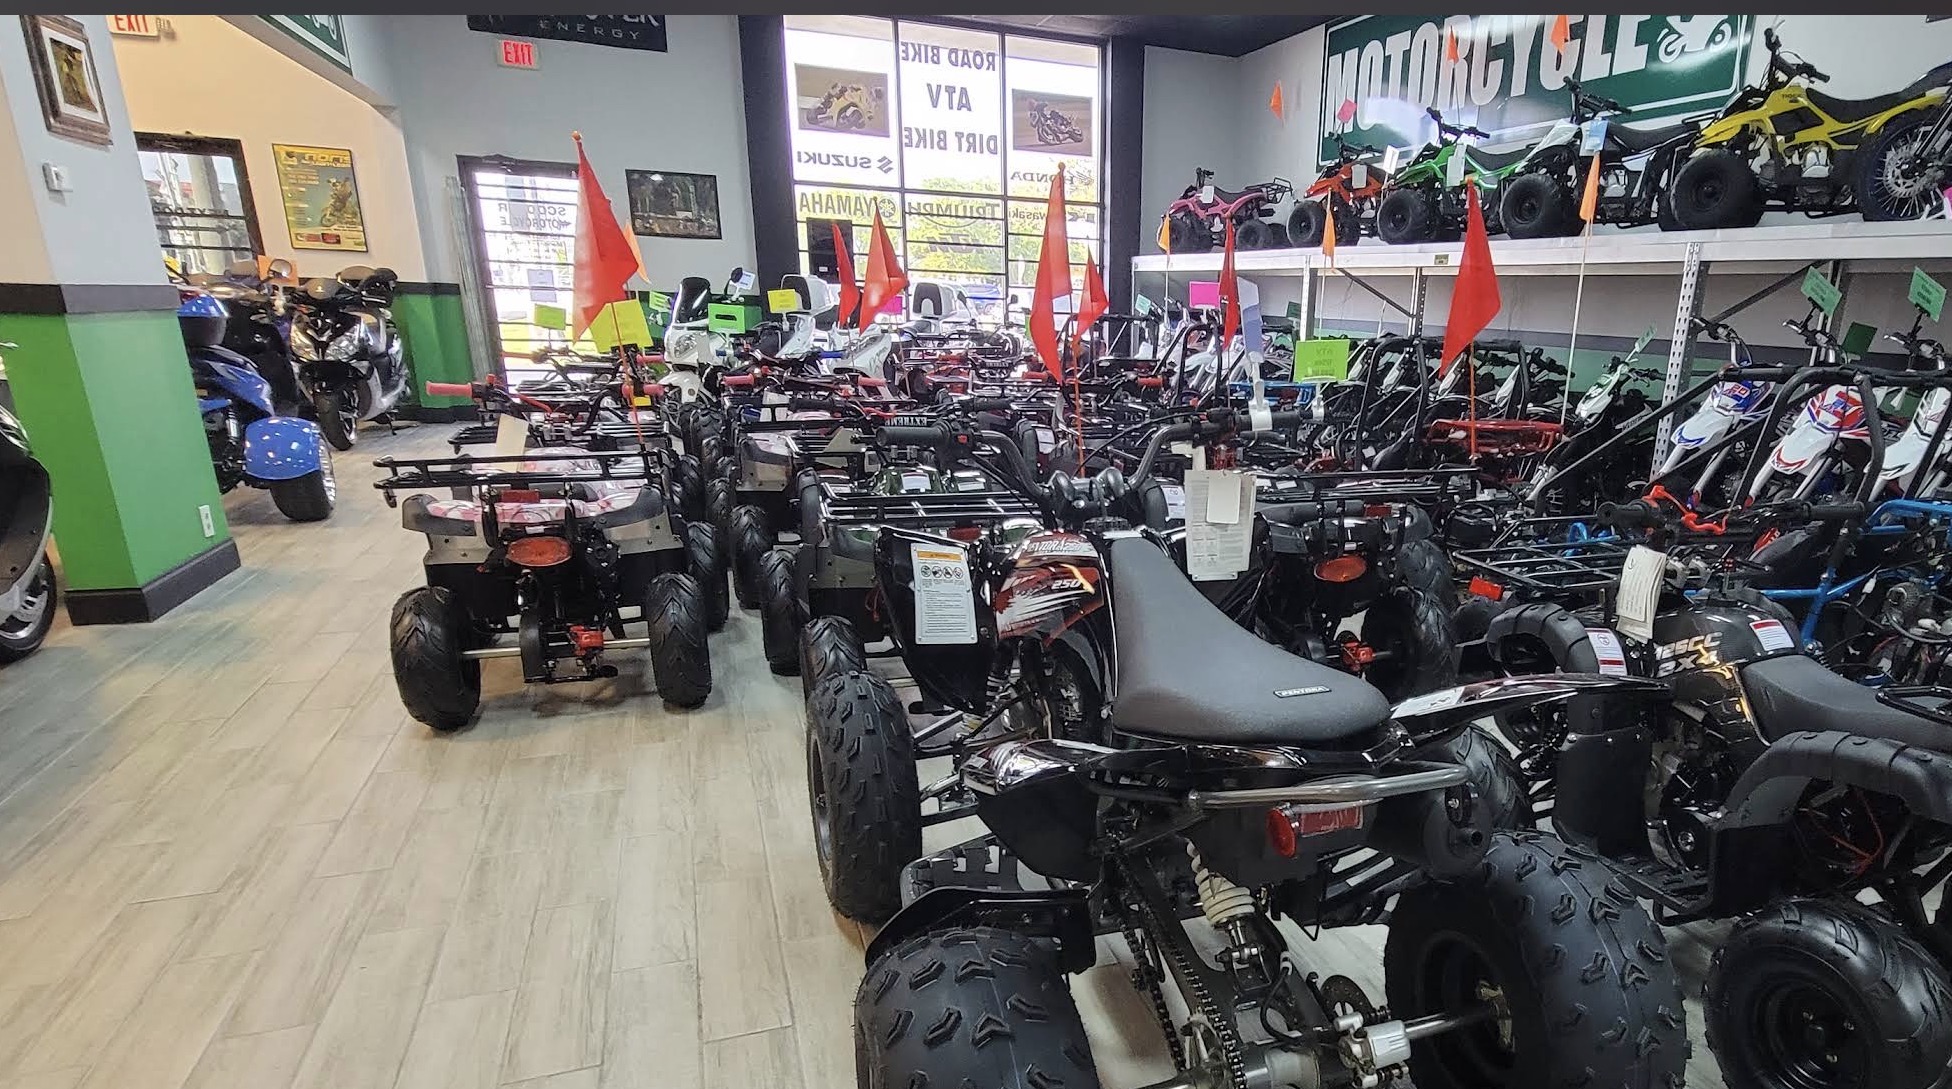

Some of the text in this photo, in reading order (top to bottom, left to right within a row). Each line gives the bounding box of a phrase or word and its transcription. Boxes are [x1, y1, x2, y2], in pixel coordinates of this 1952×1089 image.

[539, 19, 641, 40] ENERGY
[503, 41, 533, 66] EXIT
[1326, 15, 1650, 136] MOTORCYCLE
[1051, 579, 1081, 590] 250
[1653, 632, 1723, 661] 125CC
